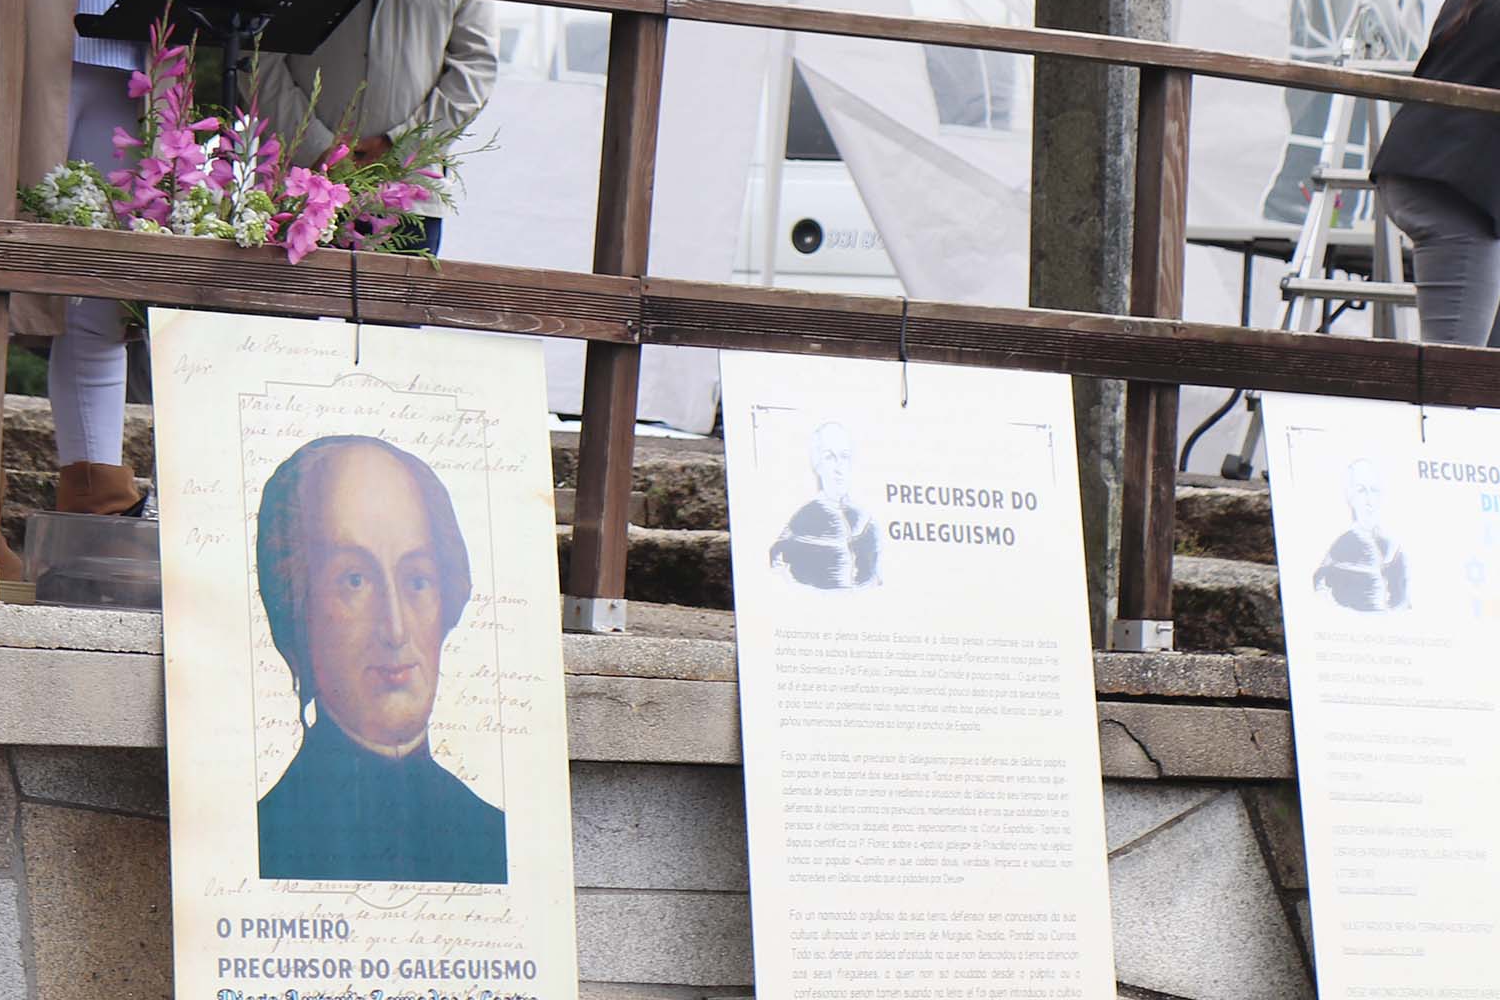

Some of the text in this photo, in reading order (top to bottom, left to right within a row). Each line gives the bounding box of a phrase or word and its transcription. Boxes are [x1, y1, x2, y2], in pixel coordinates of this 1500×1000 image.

[1418, 460, 1500, 485] RECURSO
[885, 482, 1038, 512] PRECURSOR DO
[887, 518, 1016, 548] GALEGUISMO
[216, 917, 350, 940] O PRIMEIRO
[217, 957, 538, 980] PRECURSOR DO GALEGUISMO
